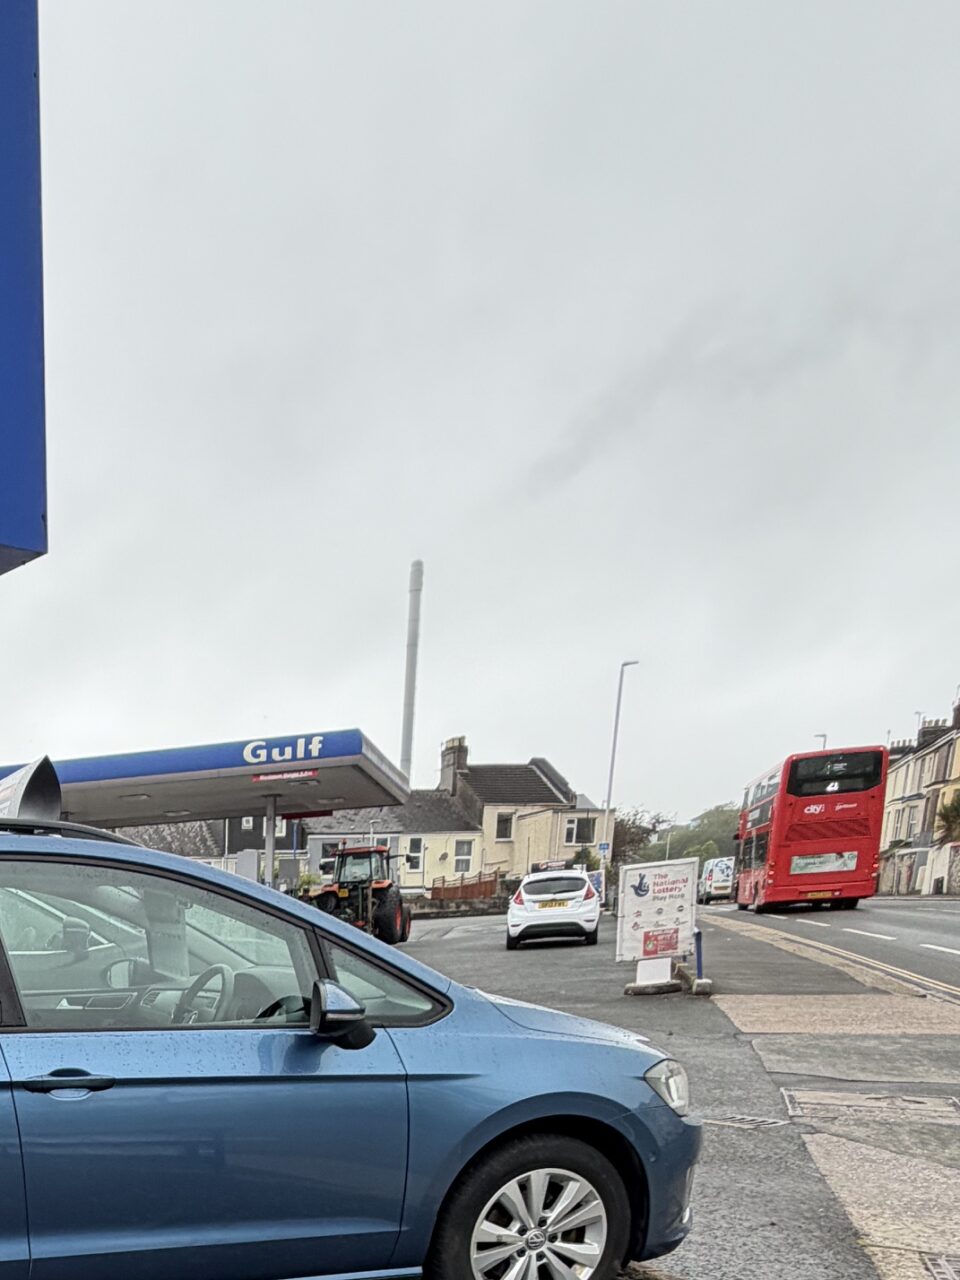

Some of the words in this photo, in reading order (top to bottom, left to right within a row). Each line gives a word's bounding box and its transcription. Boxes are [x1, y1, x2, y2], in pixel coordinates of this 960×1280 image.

[243, 736, 324, 764] Gulf
[652, 877, 689, 887] National
[652, 886, 683, 894] Lottery
